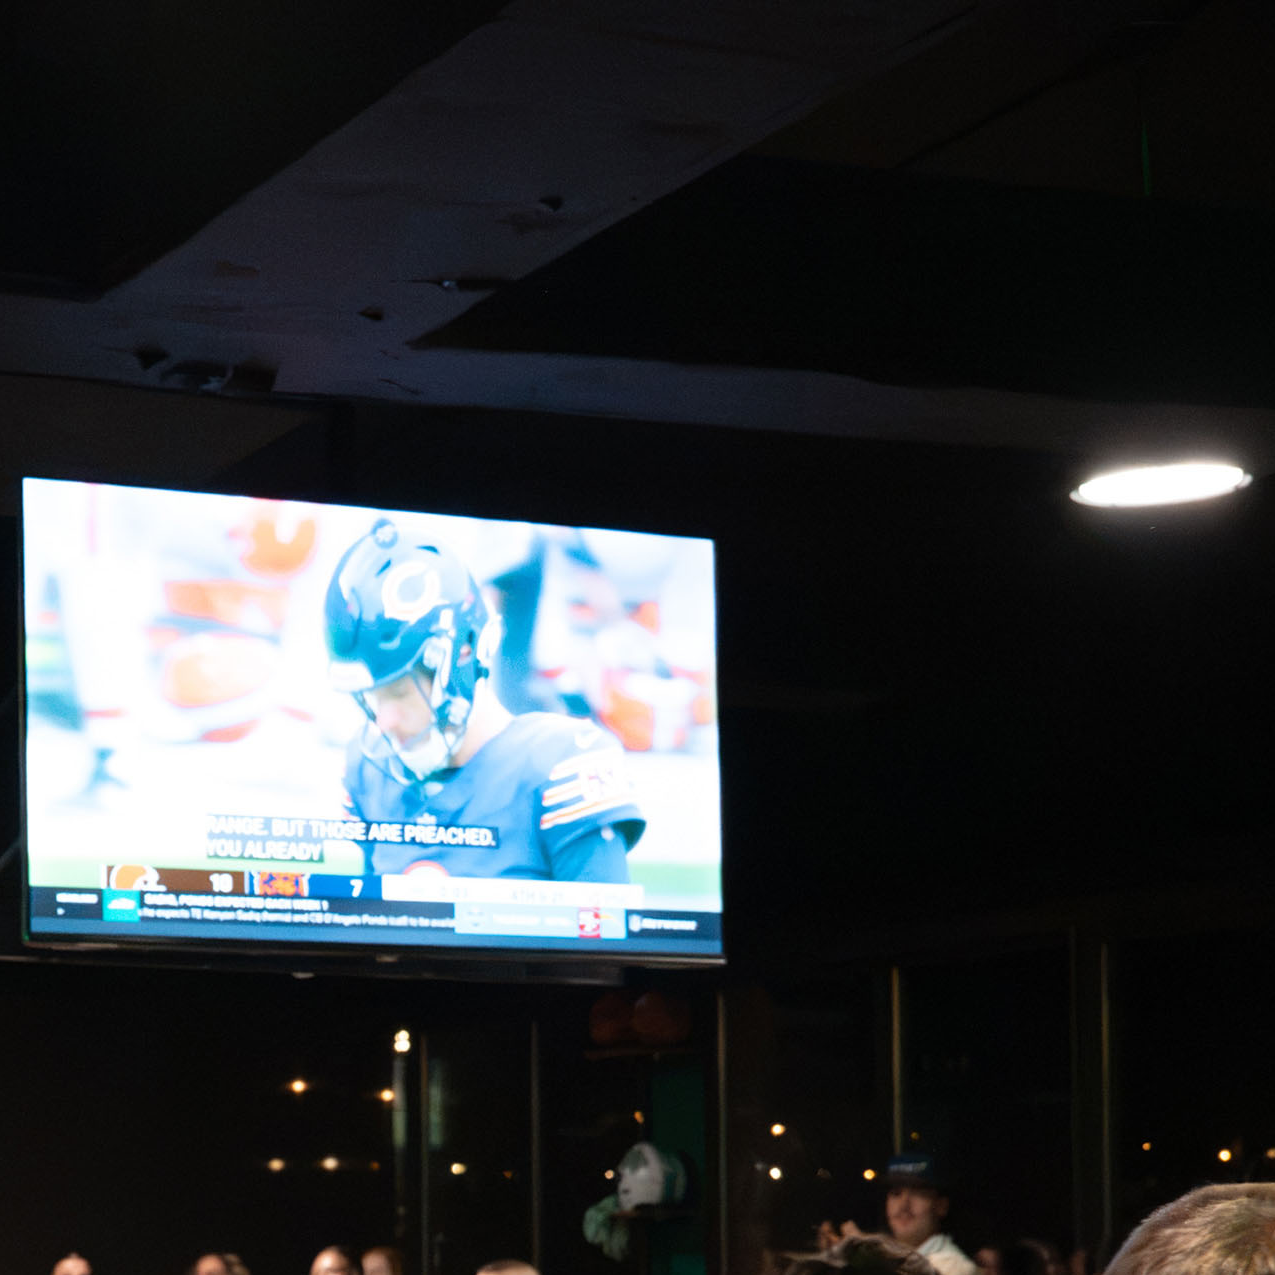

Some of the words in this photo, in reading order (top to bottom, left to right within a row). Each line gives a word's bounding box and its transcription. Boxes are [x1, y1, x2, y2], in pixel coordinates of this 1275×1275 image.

[272, 819, 306, 838] BUT
[308, 820, 367, 841] THOSE
[368, 824, 404, 842] ARE
[405, 825, 496, 846] PREACHED.
[208, 839, 242, 857] YOU
[244, 841, 321, 861] ALREADY
[350, 879, 363, 897] 7
